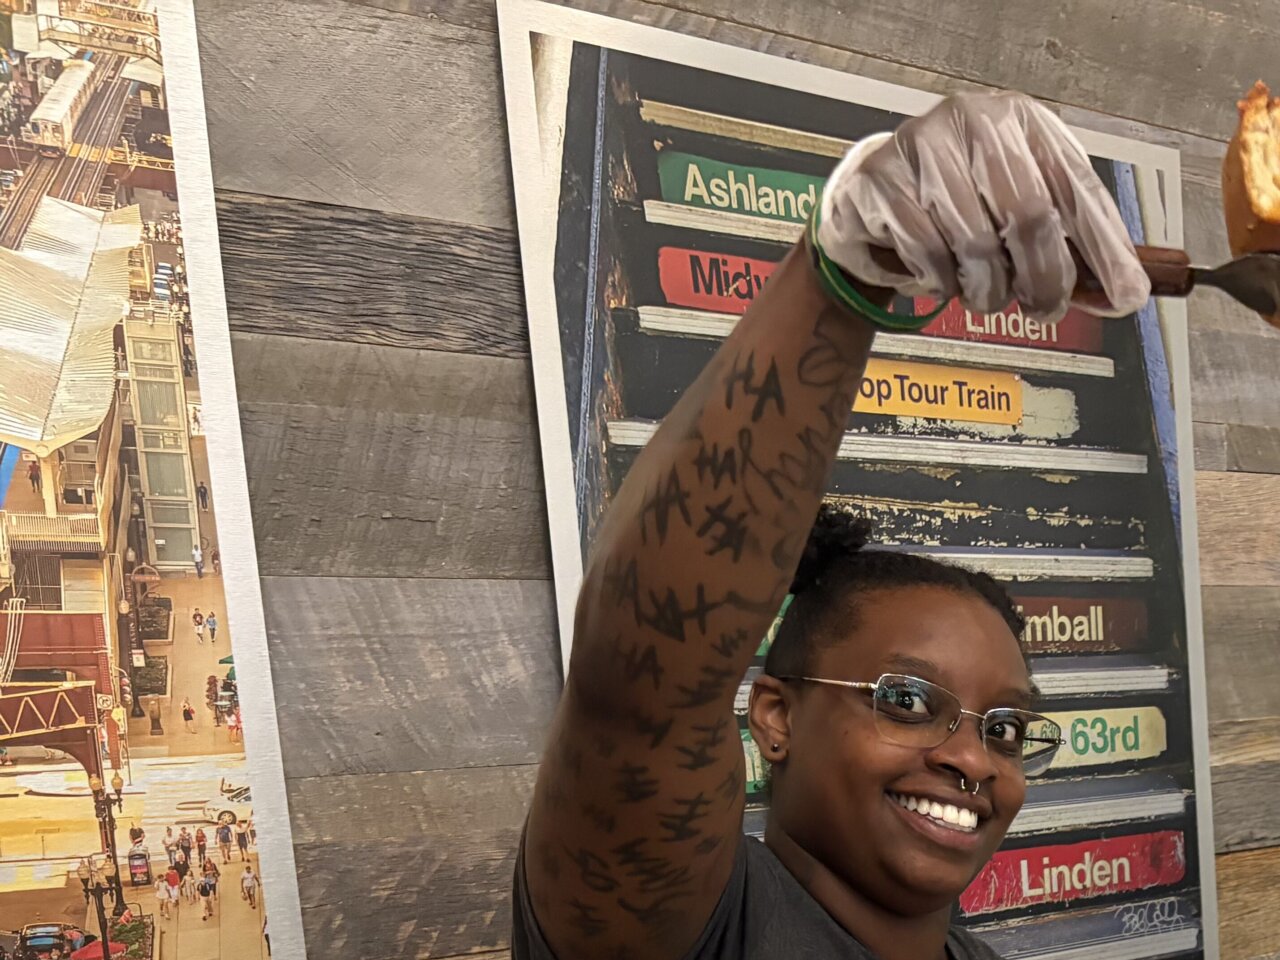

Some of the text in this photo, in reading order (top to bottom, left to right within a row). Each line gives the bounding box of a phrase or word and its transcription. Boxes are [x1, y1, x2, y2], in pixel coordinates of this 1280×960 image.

[684, 163, 817, 220] Ashland
[893, 374, 949, 405] Tour
[952, 380, 1011, 412] Train
[1071, 715, 1140, 756] 63rd
[1020, 851, 1131, 897] Linden
